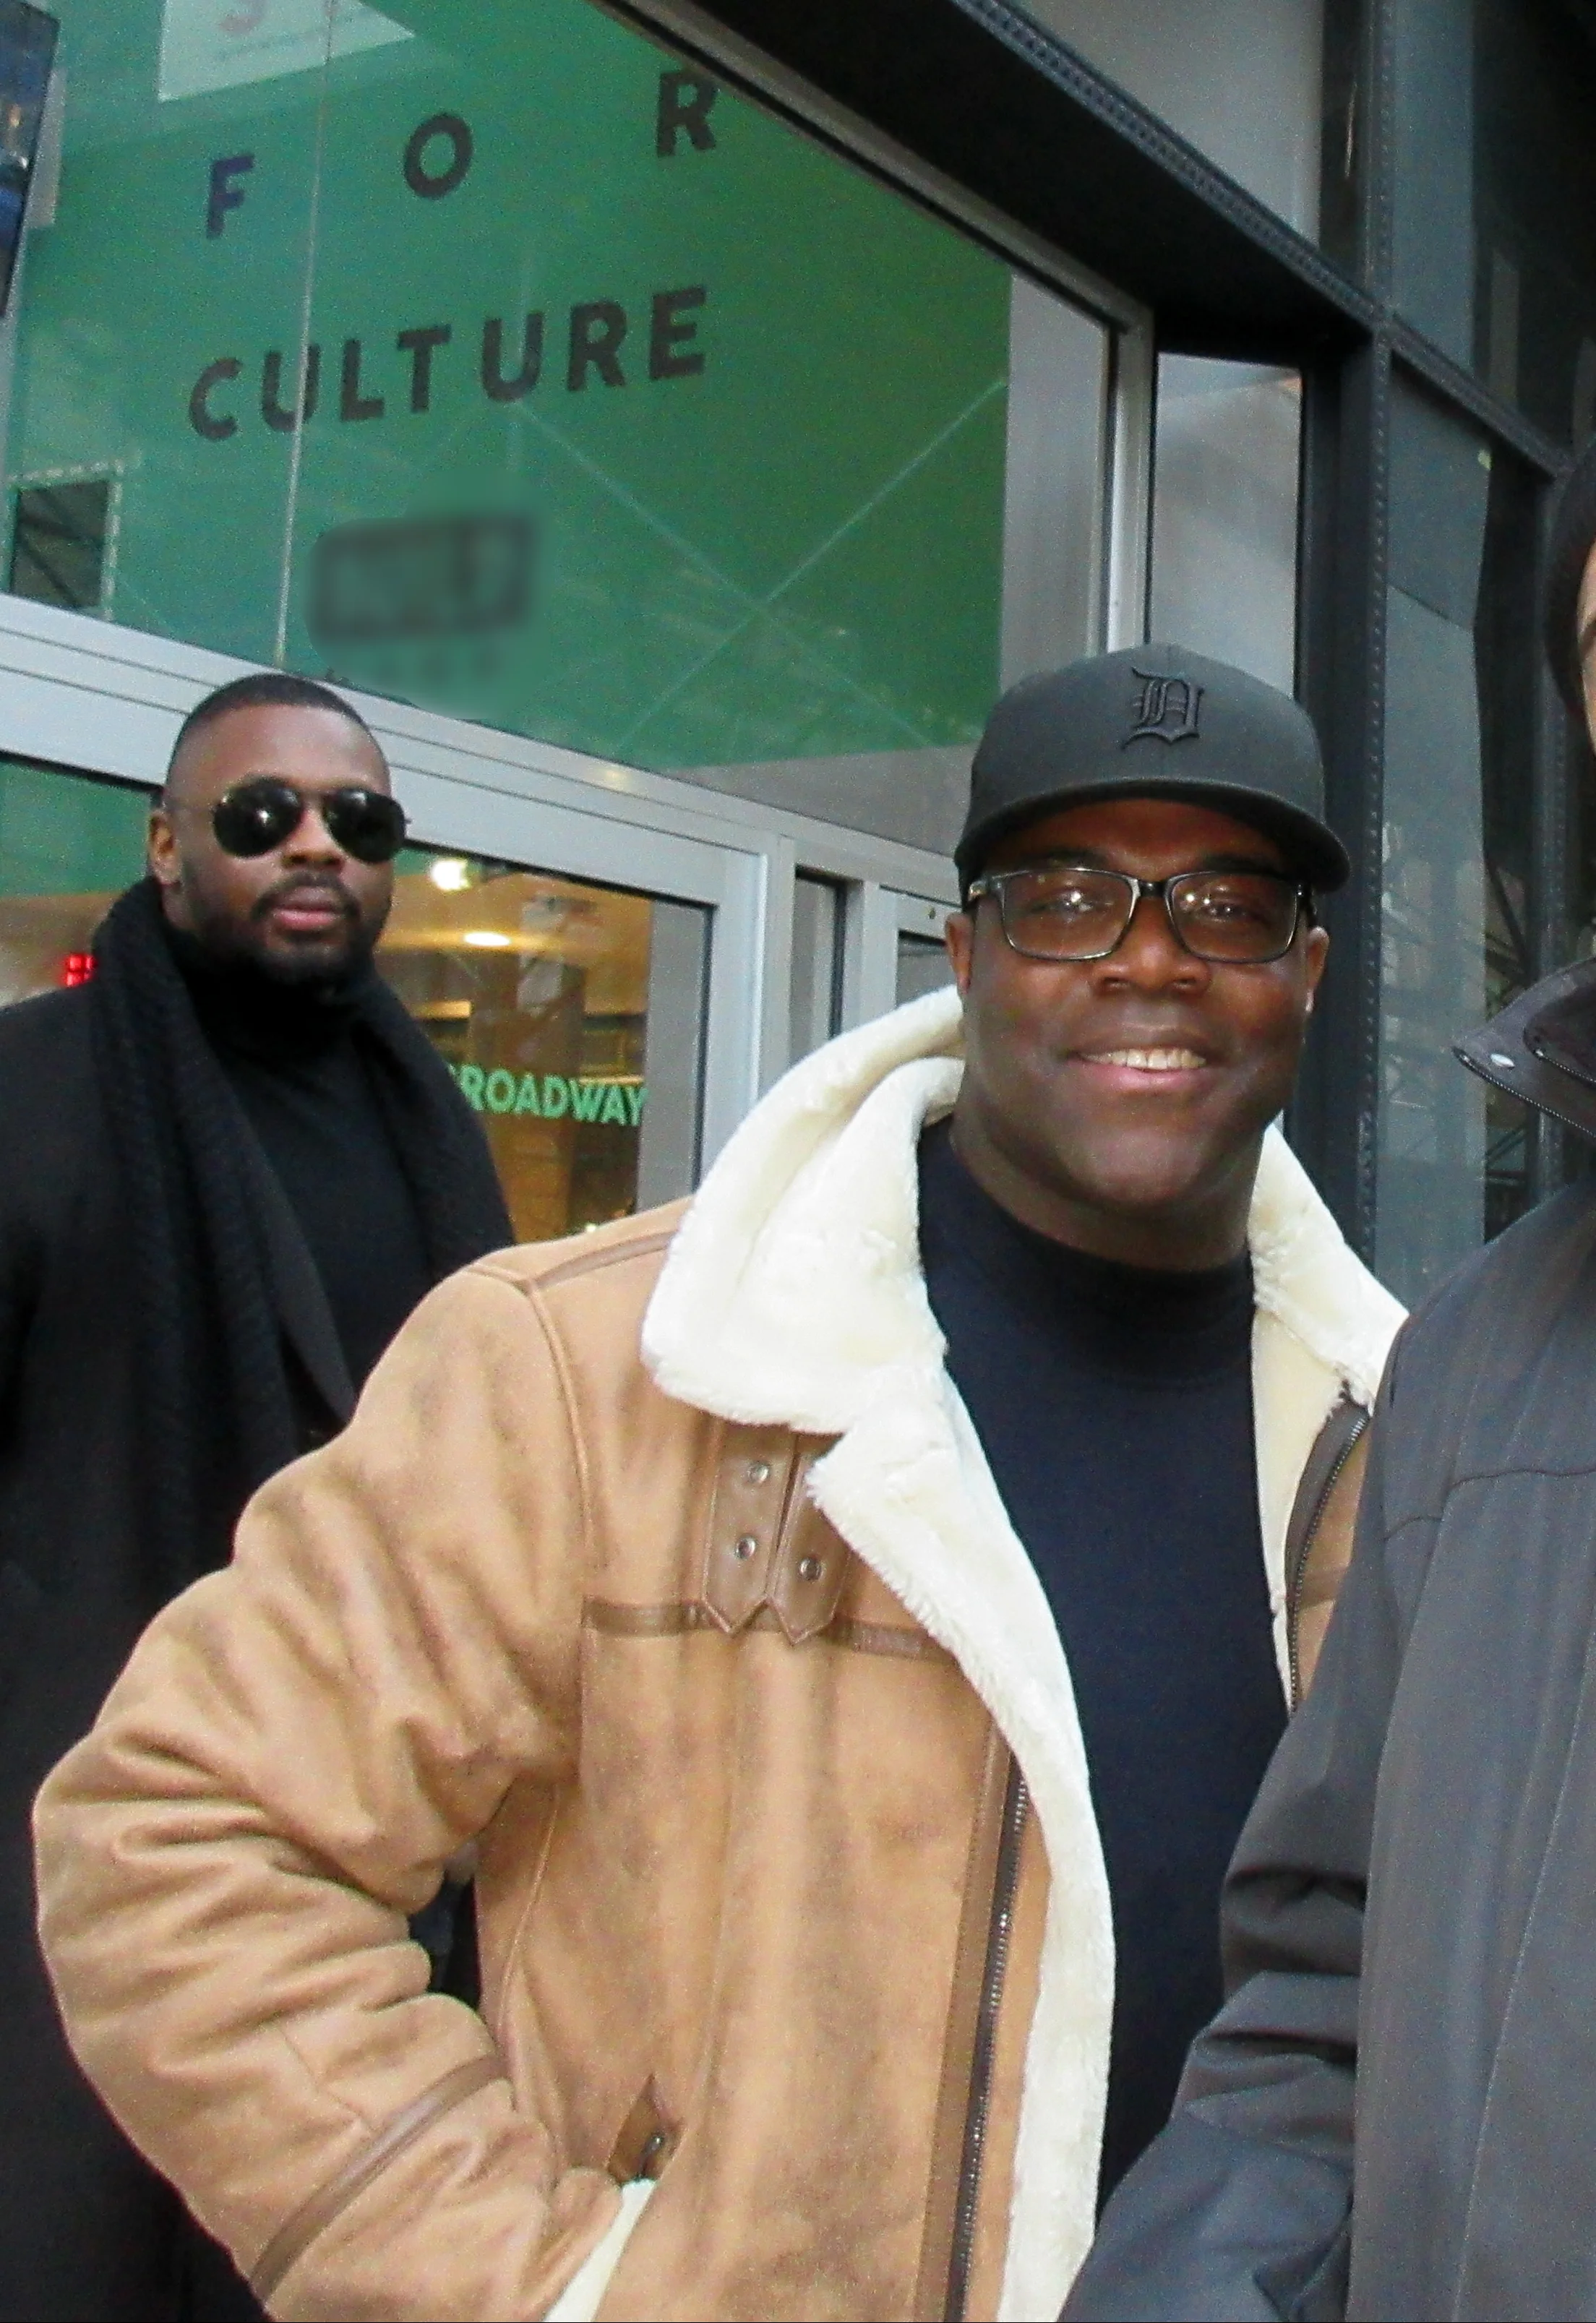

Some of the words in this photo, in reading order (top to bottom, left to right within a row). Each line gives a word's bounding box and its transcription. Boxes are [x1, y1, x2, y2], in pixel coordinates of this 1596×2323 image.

[189, 285, 707, 441] CULTURE
[1122, 666, 1205, 749] D
[447, 1062, 648, 1127] ROADWAY
